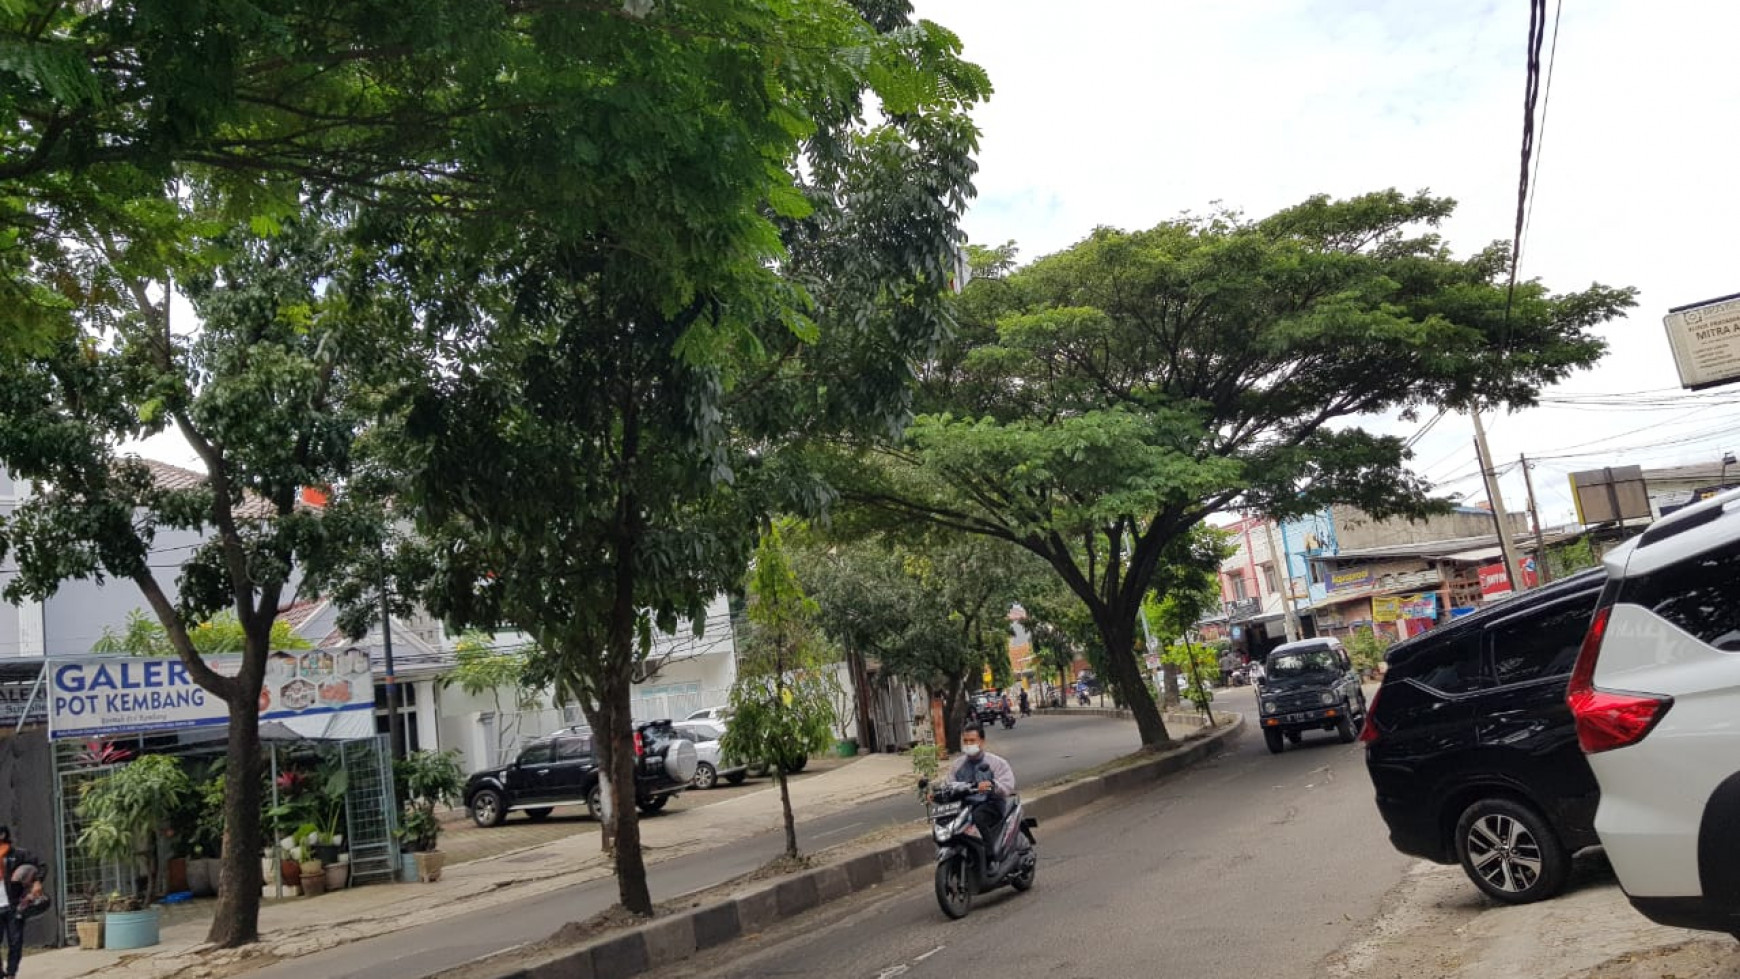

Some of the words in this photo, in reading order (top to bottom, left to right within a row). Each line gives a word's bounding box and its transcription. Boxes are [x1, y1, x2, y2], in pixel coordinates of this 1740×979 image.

[1695, 325, 1730, 340] MITRA
[56, 662, 192, 692] GALER
[56, 695, 98, 716] POT
[105, 688, 205, 713] KEMBANG
